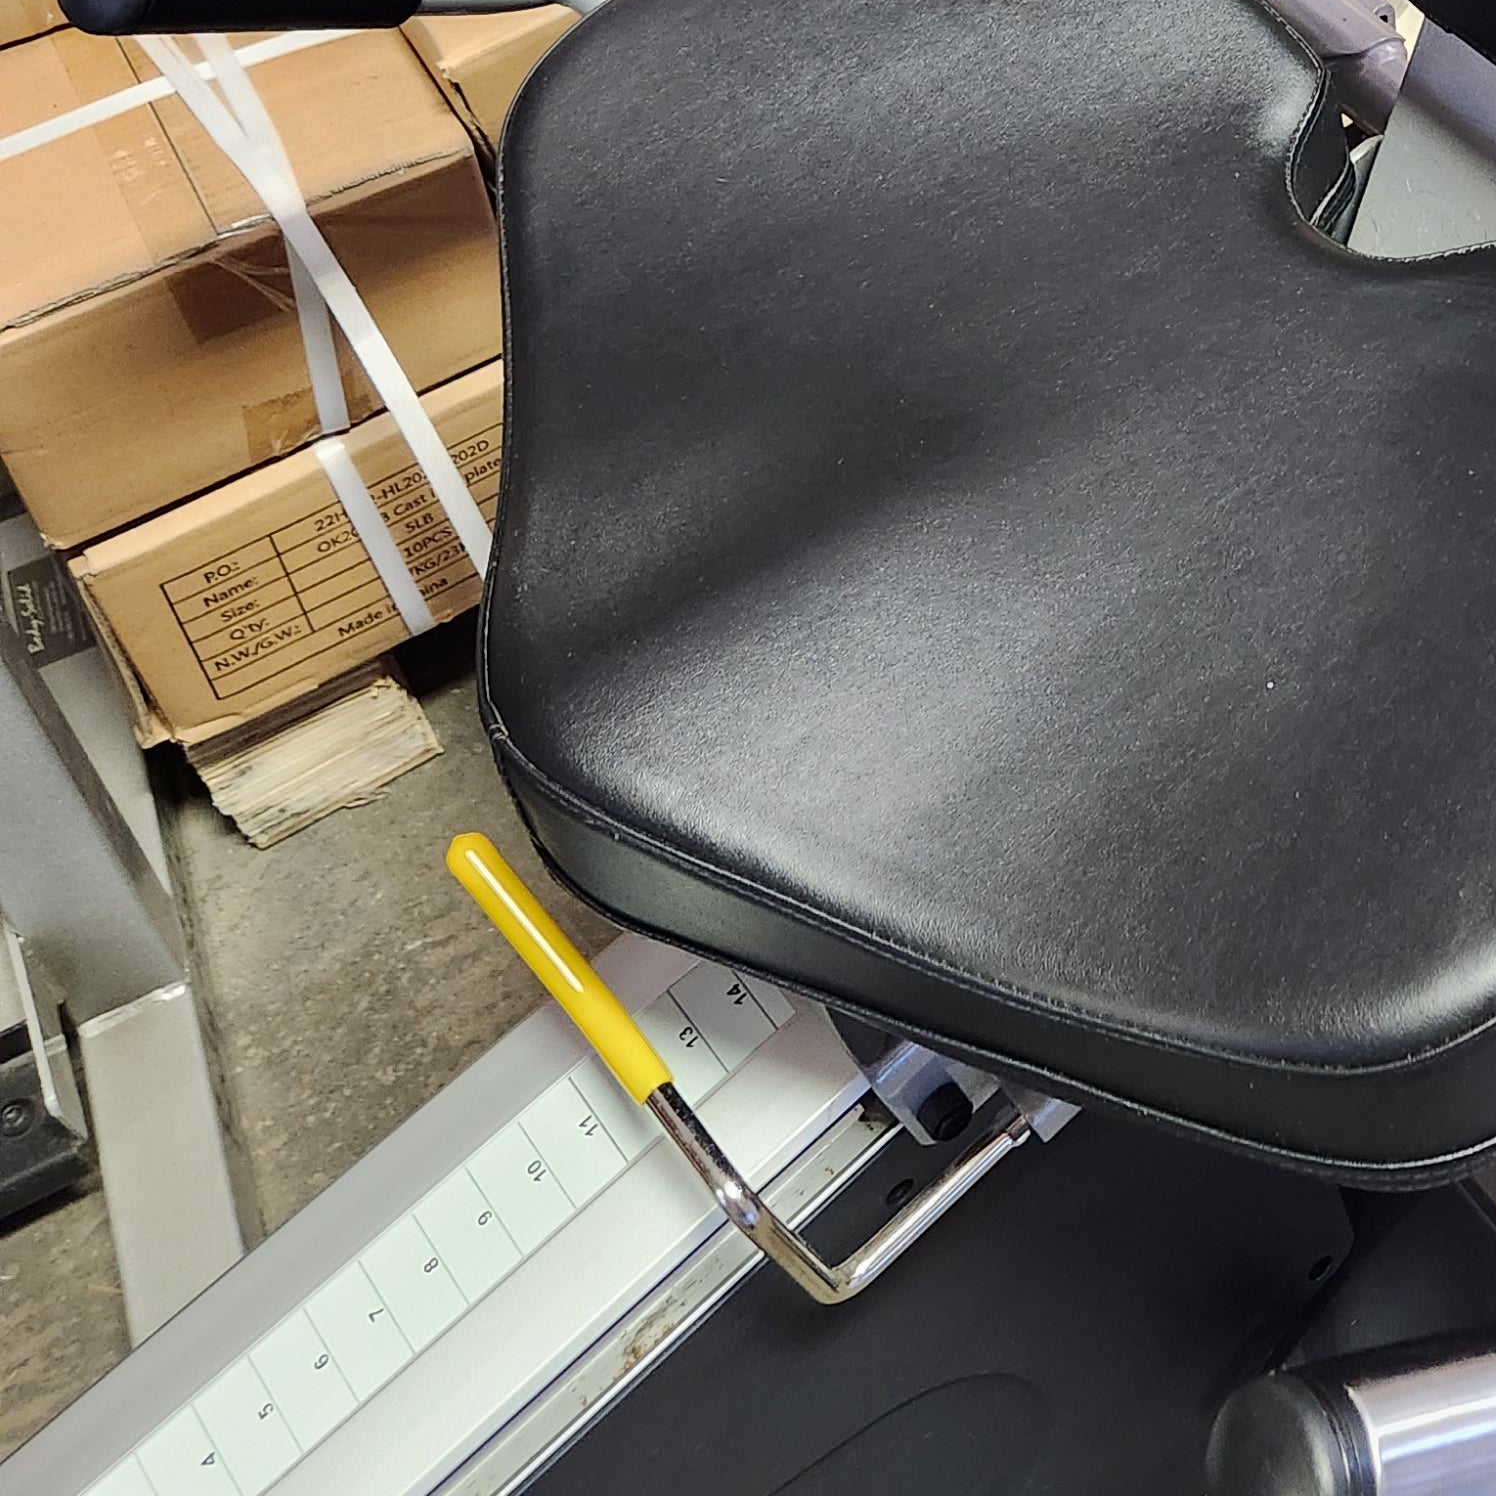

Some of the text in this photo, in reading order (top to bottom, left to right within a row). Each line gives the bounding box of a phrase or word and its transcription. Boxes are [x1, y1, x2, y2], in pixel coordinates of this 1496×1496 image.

[203, 577, 258, 608] Name:
[393, 495, 428, 516] Cast
[403, 526, 456, 558] 10PCS
[220, 513, 434, 623] Size: 5LB
[337, 611, 383, 637] Made
[725, 982, 749, 1005] 14
[679, 1025, 700, 1048] 13
[578, 1114, 599, 1137] 11
[527, 1159, 547, 1182] 10
[477, 1210, 493, 1226] 9
[423, 1257, 439, 1273] 8
[368, 1307, 385, 1323] 7
[313, 1354, 330, 1370] 6
[257, 1403, 274, 1420] 5
[200, 1450, 216, 1467] 4
